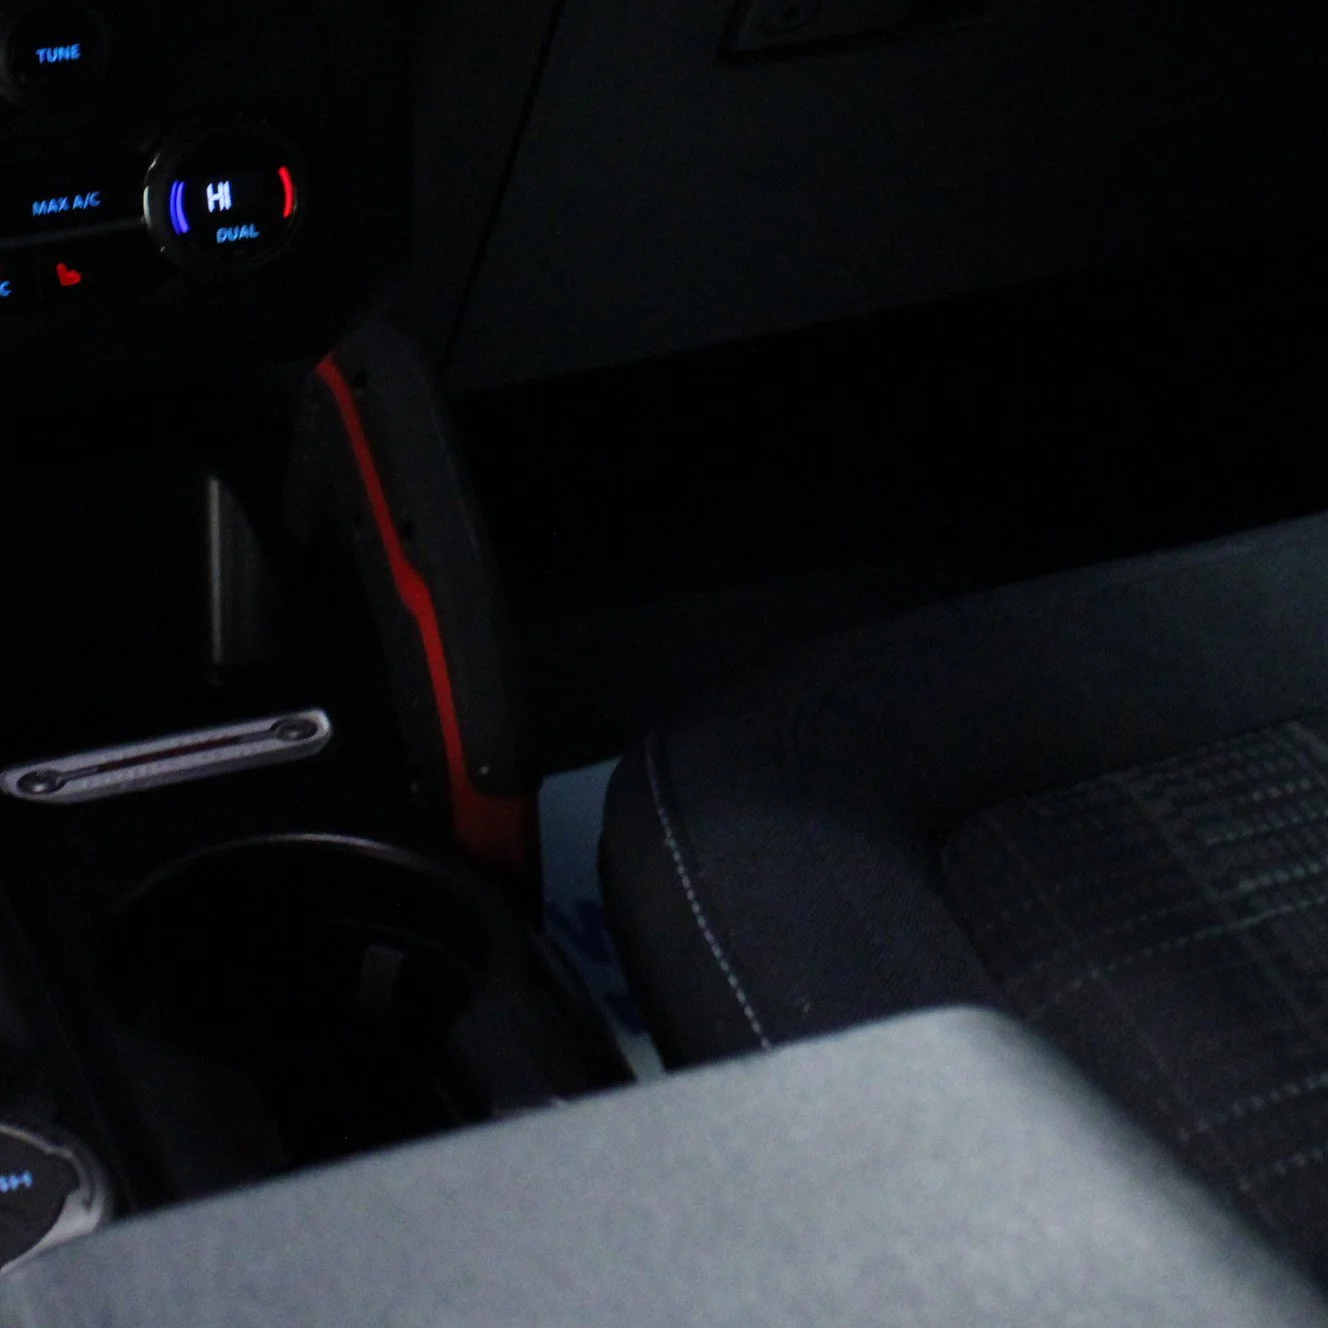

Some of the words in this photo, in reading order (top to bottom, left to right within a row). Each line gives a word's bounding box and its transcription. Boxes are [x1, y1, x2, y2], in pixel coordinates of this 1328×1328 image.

[35, 43, 81, 64] TUNE
[32, 196, 70, 216] MAX
[72, 190, 102, 210] A/C
[206, 180, 232, 213] HI
[216, 223, 260, 244] DUAL
